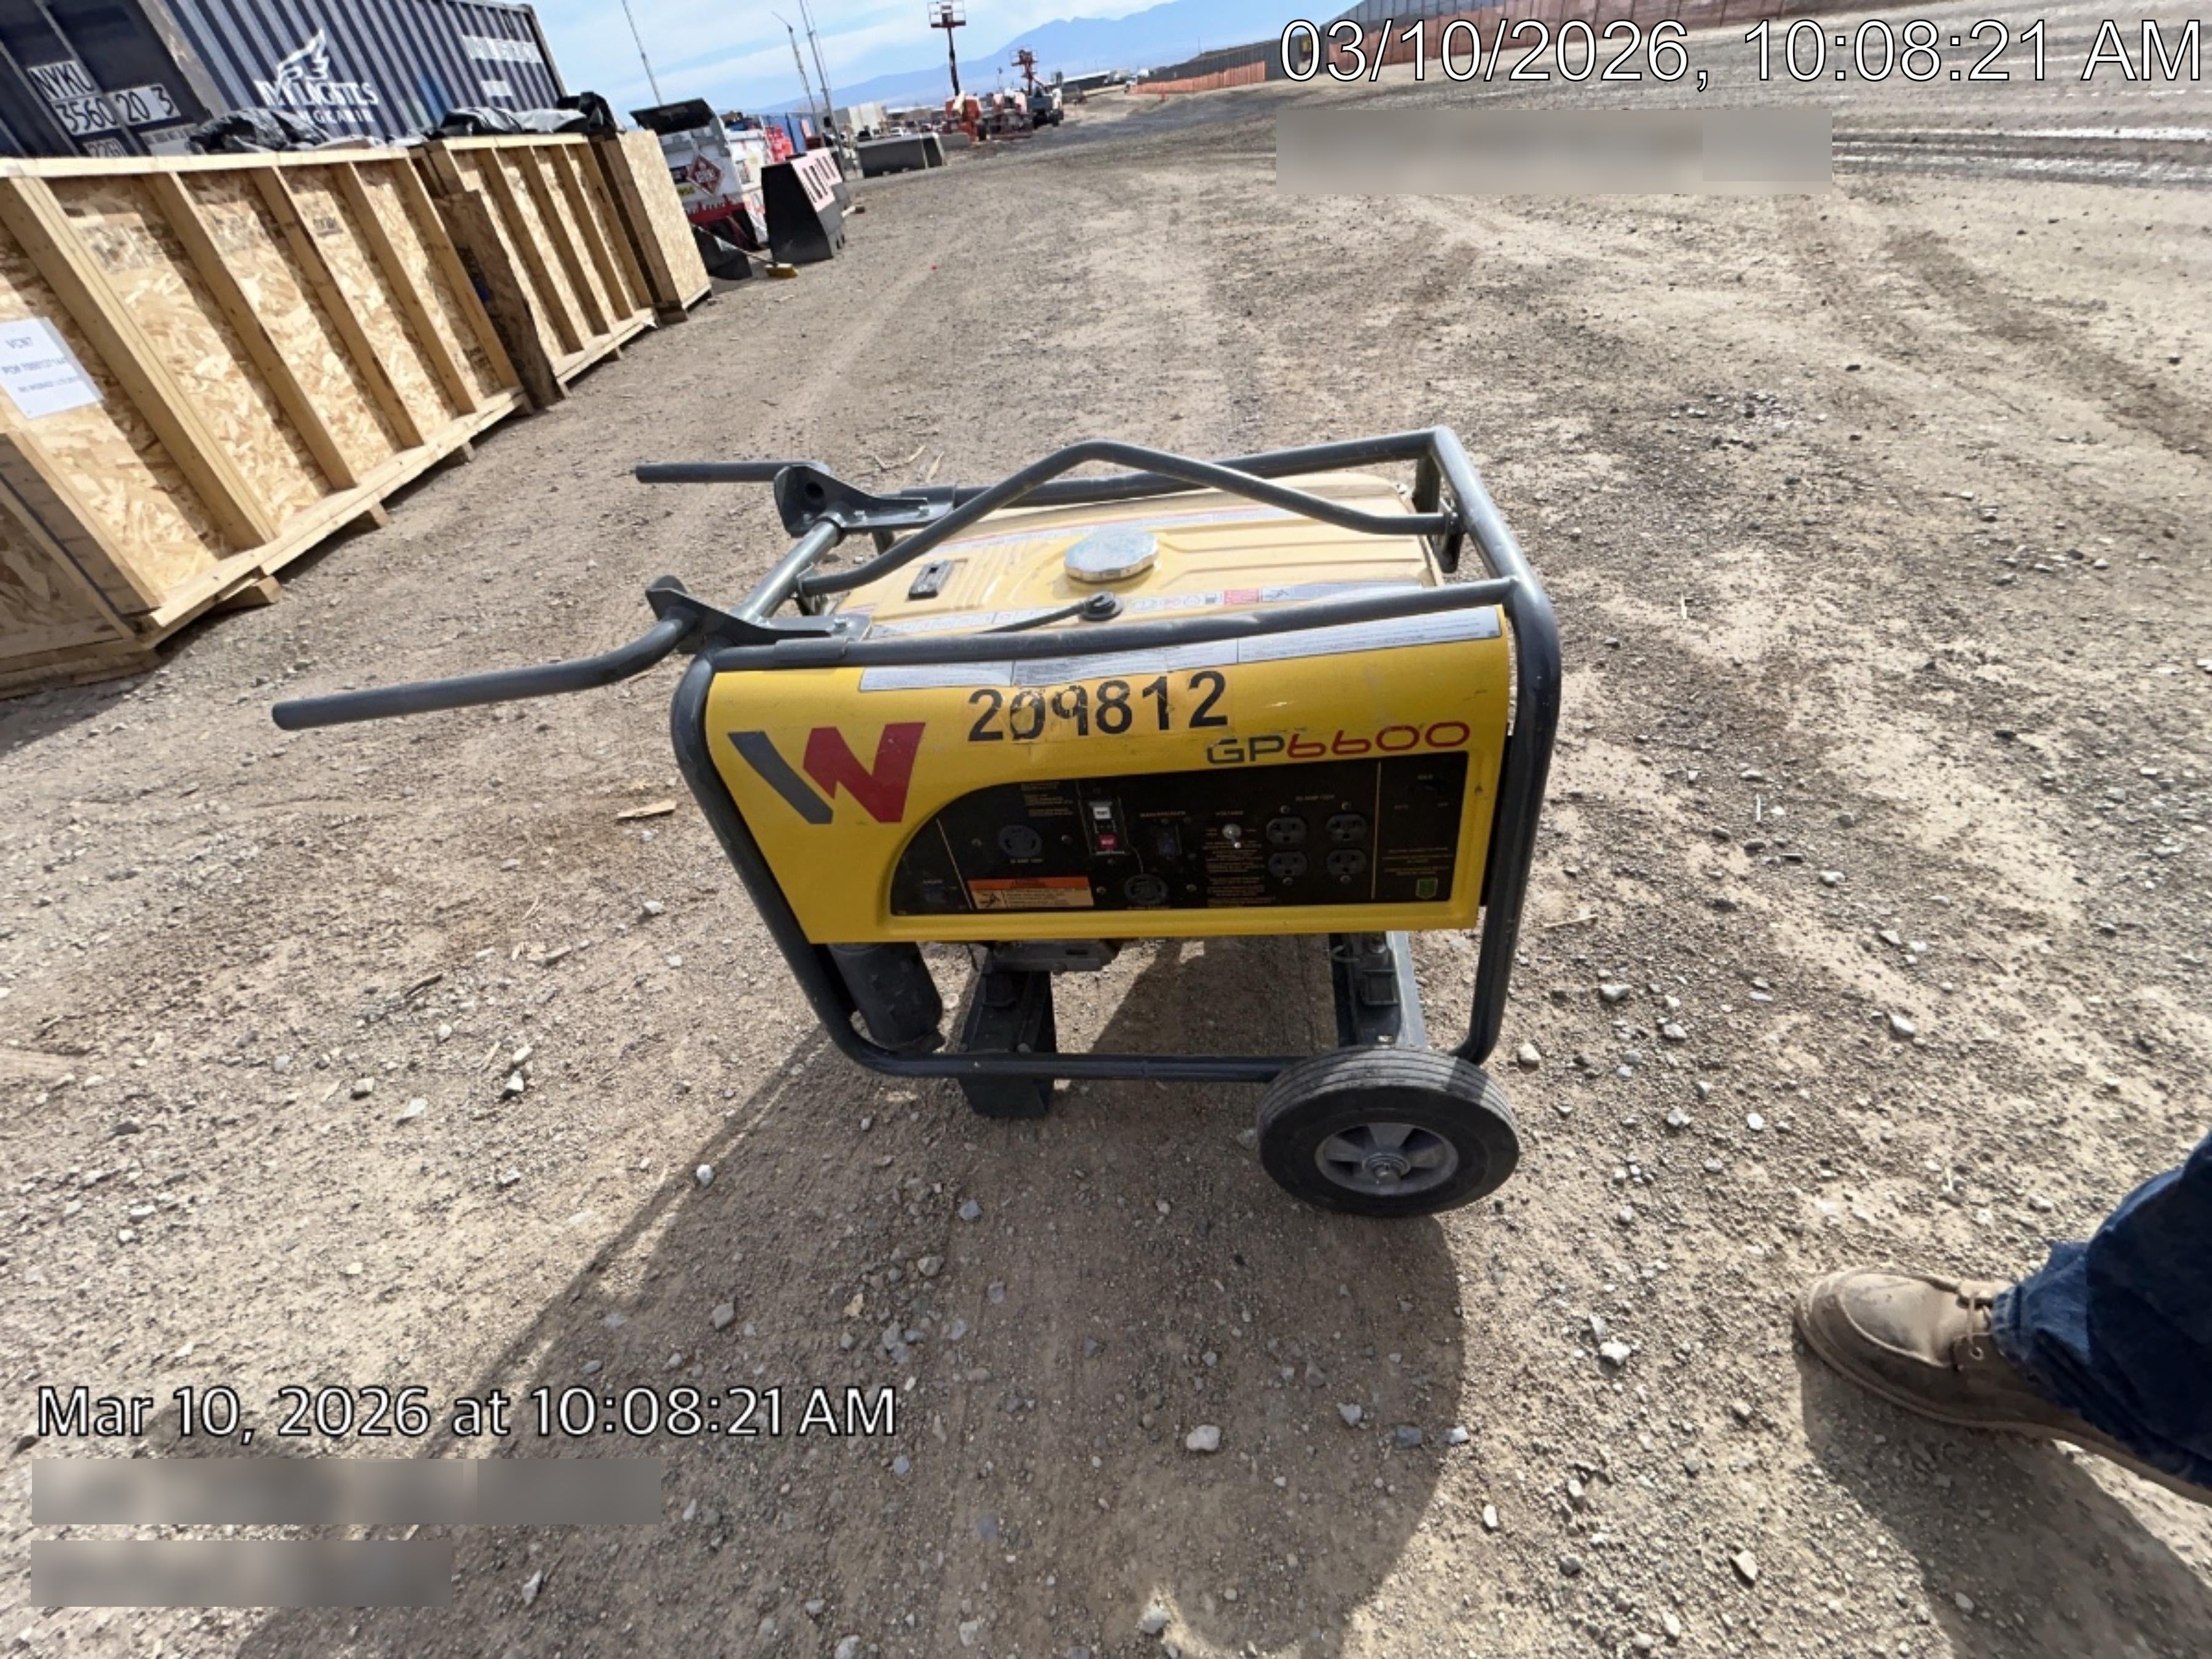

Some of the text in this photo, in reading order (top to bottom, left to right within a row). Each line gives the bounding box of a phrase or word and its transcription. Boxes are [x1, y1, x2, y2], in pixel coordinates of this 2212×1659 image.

[56, 86, 175, 133] 3560 20 3
[968, 670, 1228, 741] 209812
[1207, 721, 1470, 764] GP6600
